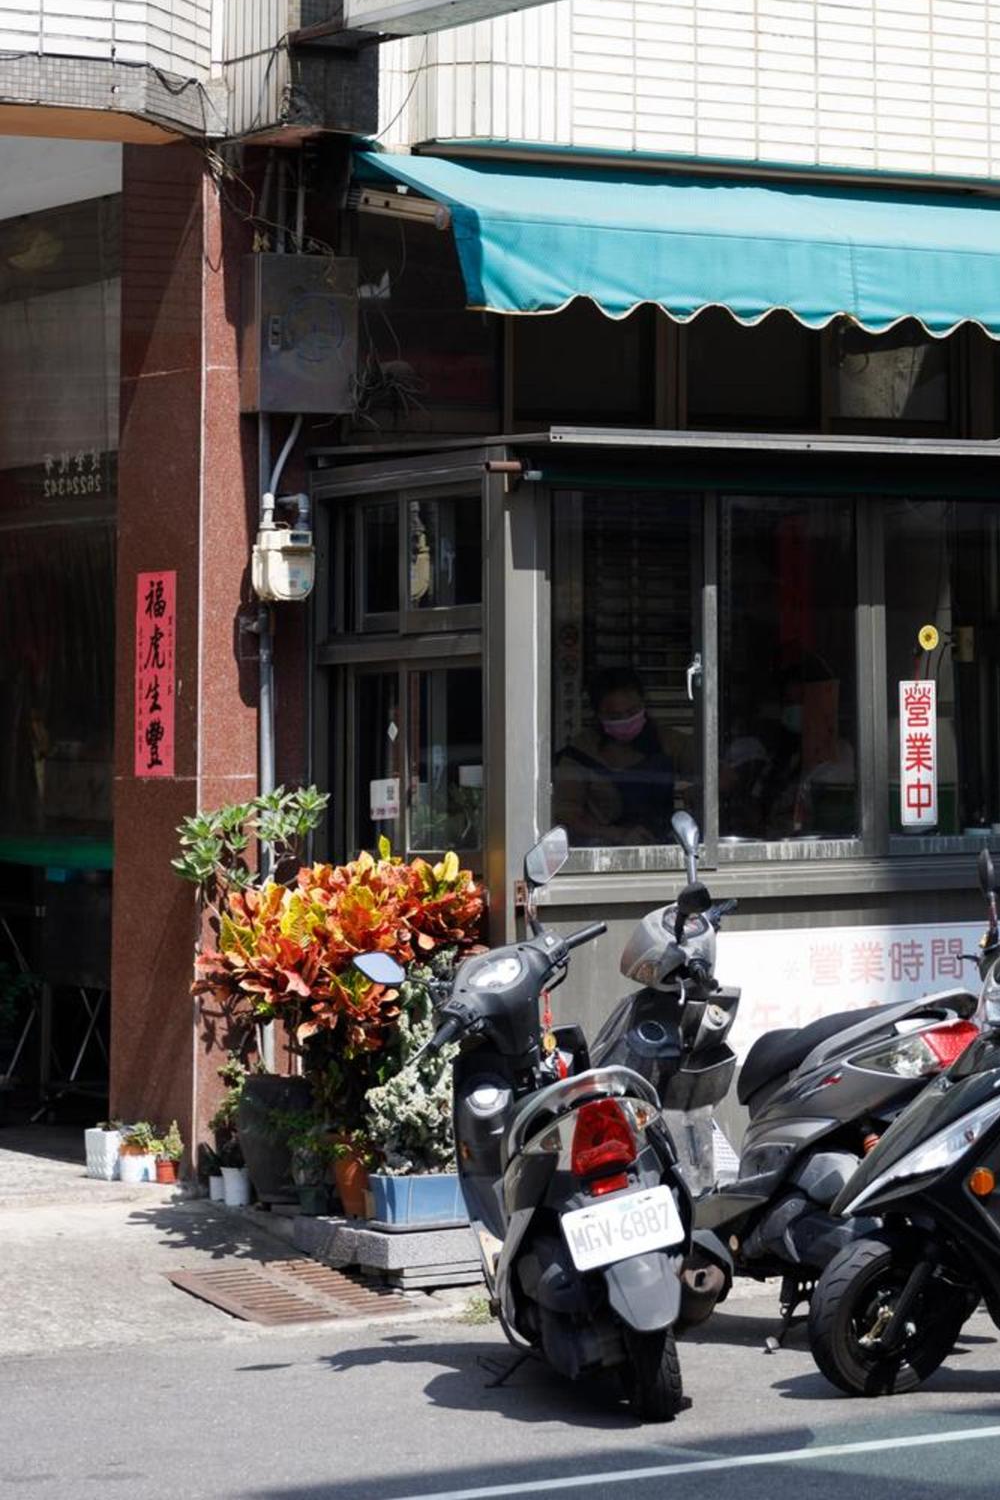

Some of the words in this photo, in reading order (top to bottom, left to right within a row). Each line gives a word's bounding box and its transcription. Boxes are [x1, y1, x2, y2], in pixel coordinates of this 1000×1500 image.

[904, 685, 933, 819] 營業中
[808, 938, 964, 986] 營業時間
